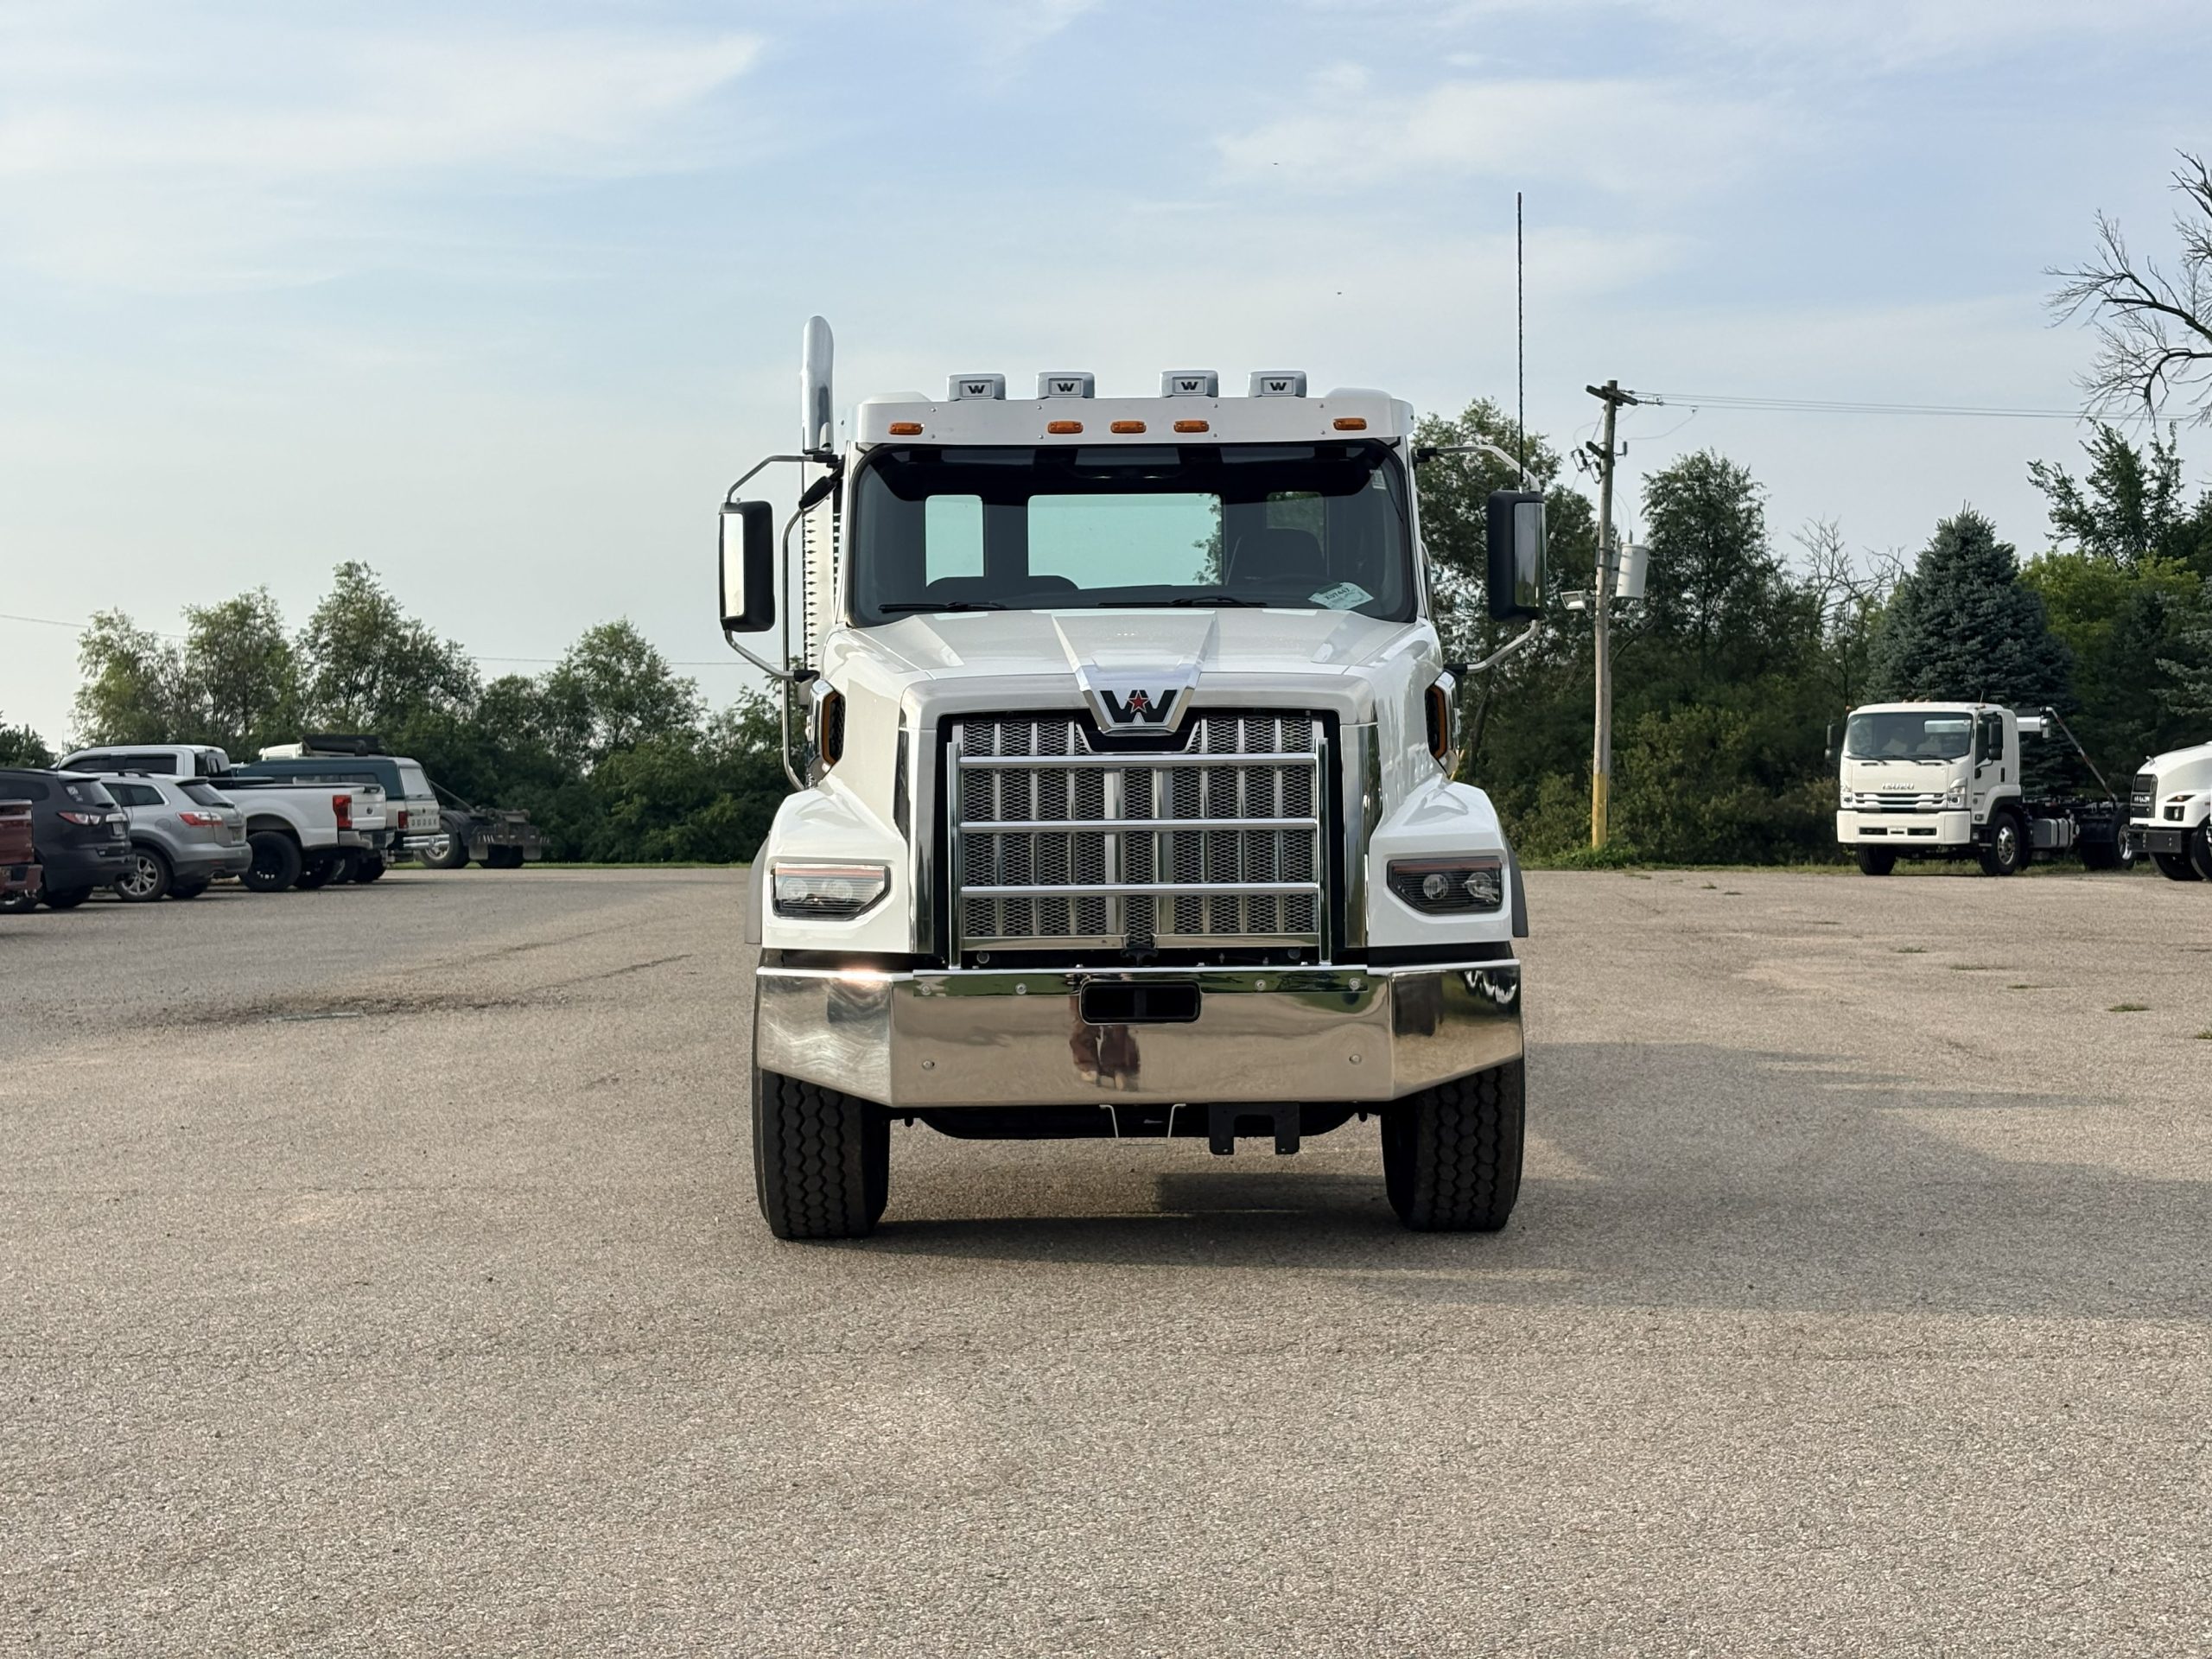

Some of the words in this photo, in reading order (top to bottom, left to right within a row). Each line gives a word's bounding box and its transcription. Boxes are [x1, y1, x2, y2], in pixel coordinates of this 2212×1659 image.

[968, 385, 986, 394] W
[1057, 383, 1075, 392] W
[1180, 381, 1198, 391] W
[1269, 382, 1287, 391] W
[1099, 690, 1178, 723] W
